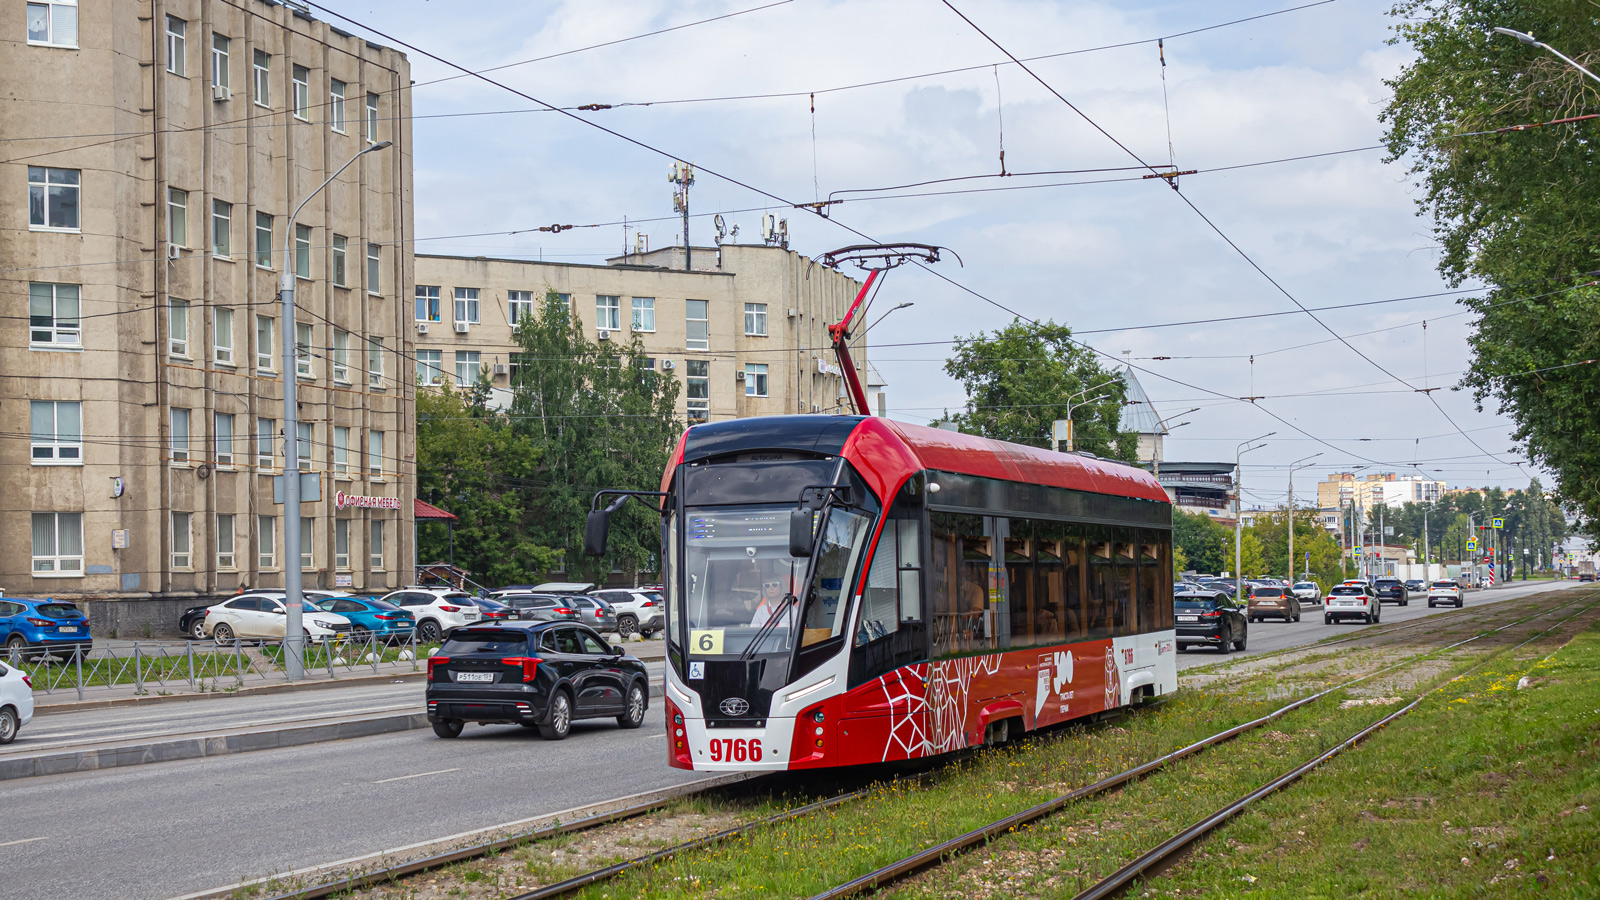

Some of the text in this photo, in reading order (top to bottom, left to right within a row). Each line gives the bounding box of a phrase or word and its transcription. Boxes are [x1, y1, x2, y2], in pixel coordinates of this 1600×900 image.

[345, 495, 401, 509] ОФИСНАЯ МЕБЕЛЬ
[698, 633, 714, 651] 6
[1125, 648, 1133, 665] 9766
[709, 738, 763, 762] 9766
